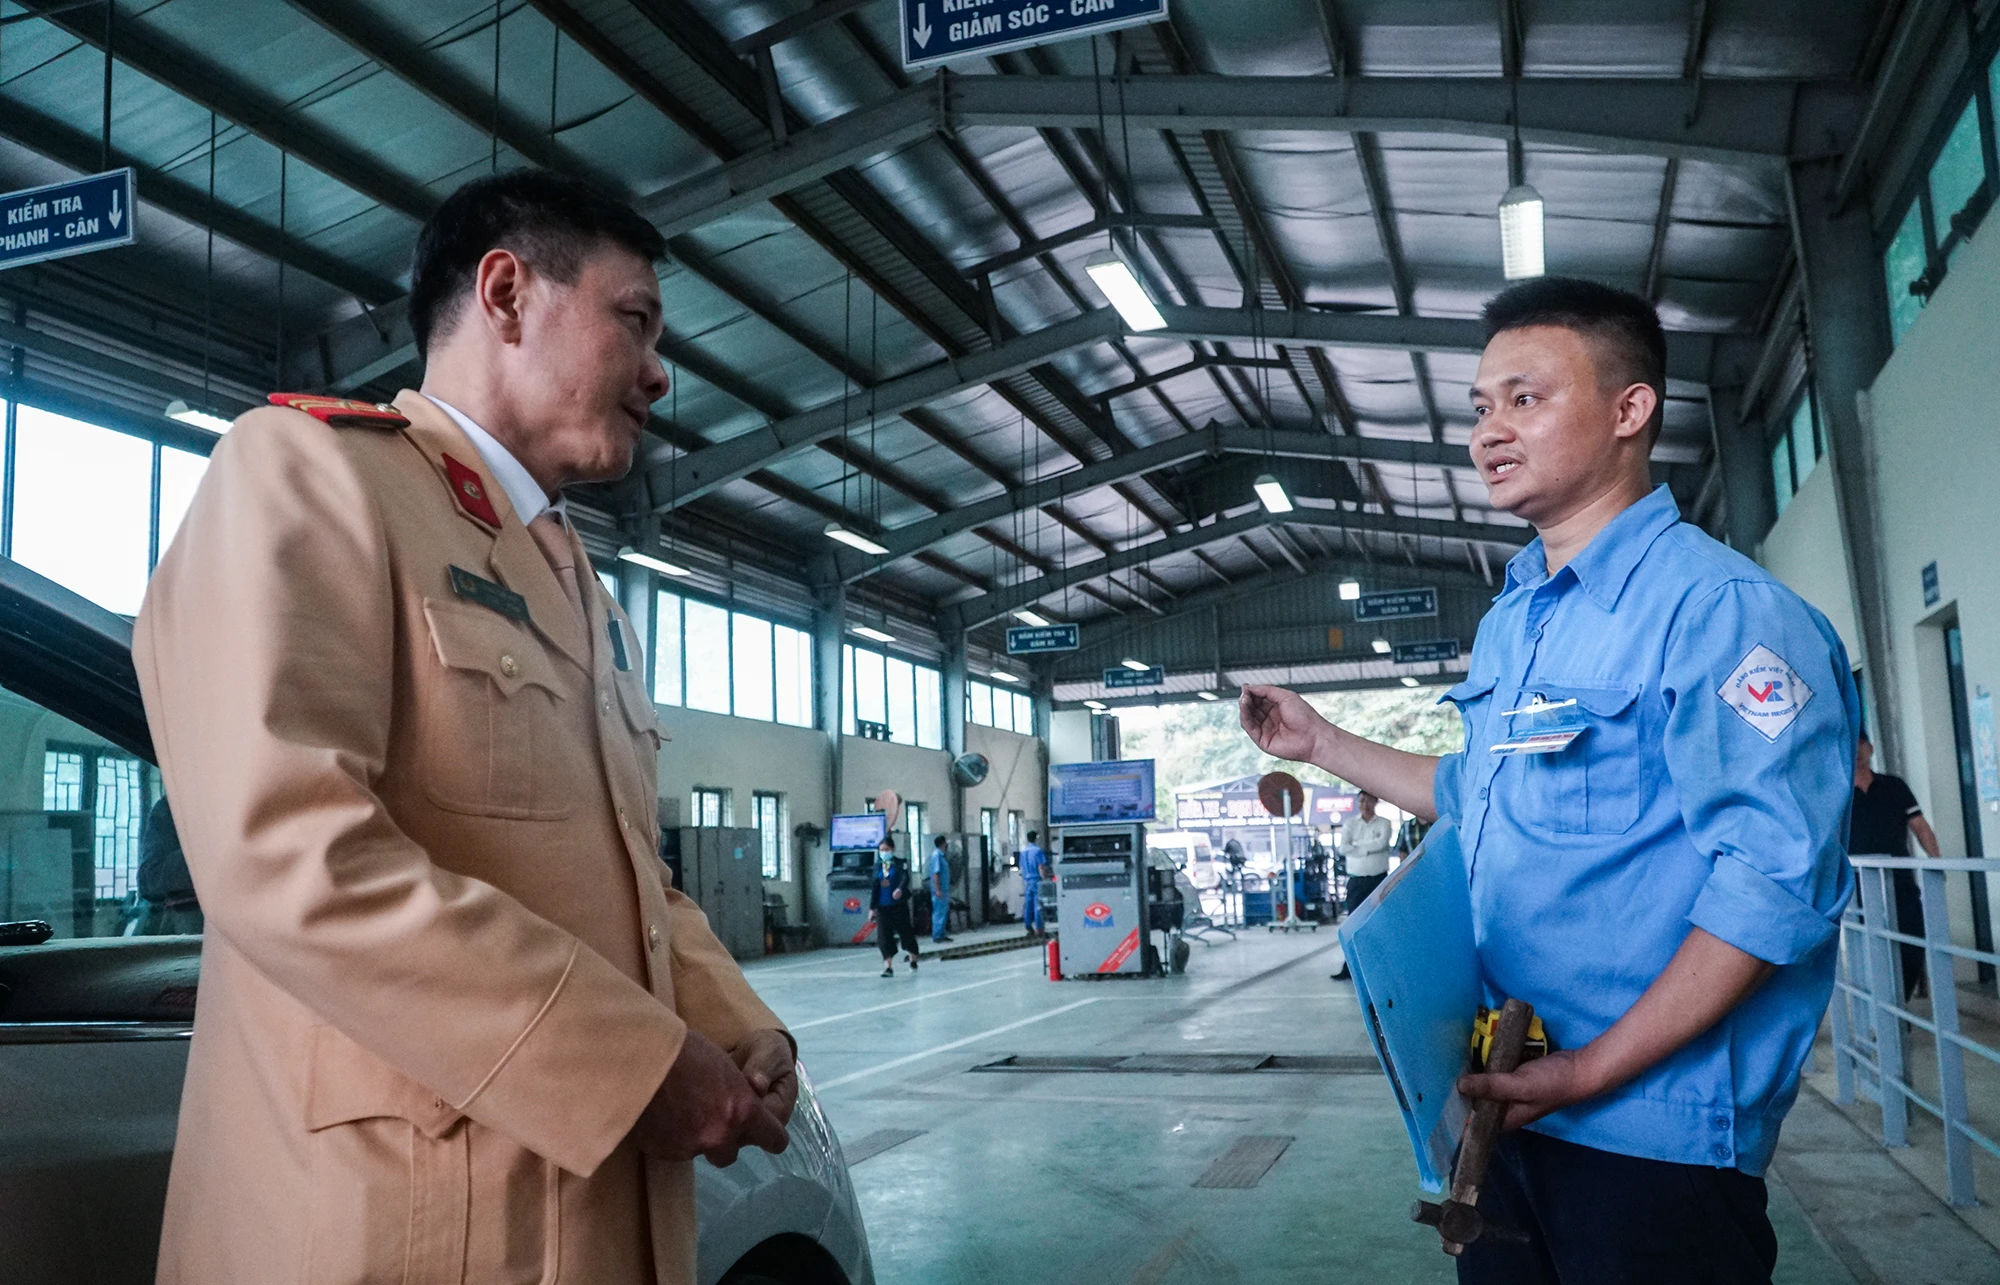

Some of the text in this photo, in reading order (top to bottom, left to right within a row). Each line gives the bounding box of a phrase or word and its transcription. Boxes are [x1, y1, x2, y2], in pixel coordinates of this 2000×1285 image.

[949, 11, 1002, 42] GIẢM
[1008, 2, 1049, 29] SÓC
[8, 195, 83, 225] KIỂM TRA
[65, 216, 99, 239] CÂN
[1739, 702, 1769, 717] VIETNAM
